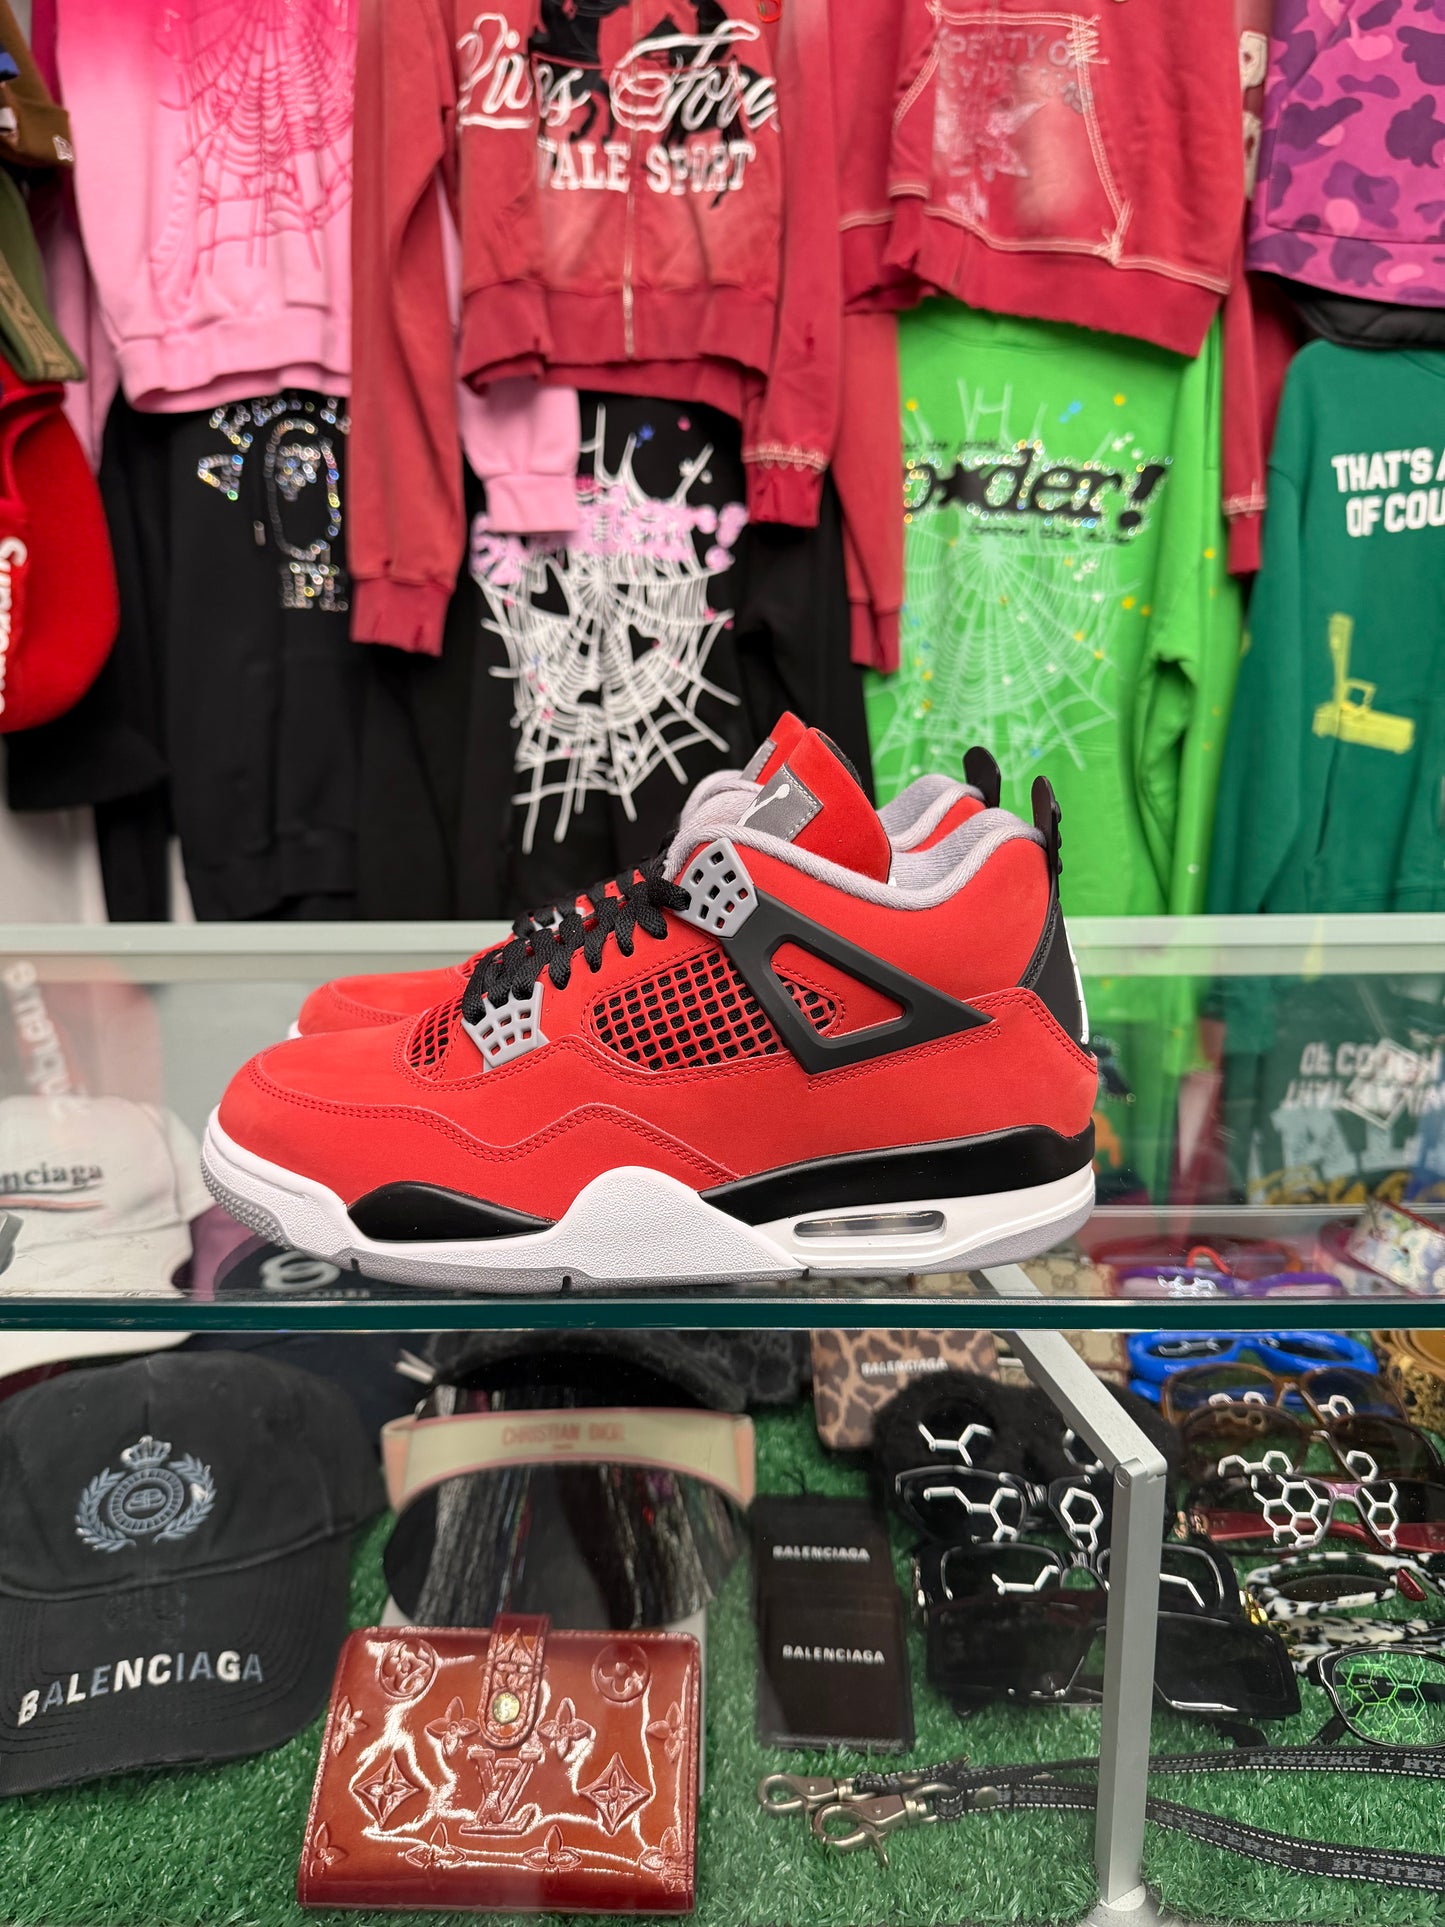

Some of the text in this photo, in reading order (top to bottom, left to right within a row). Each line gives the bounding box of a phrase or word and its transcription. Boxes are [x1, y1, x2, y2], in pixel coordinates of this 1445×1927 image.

[1331, 447, 1434, 493] THAT'S
[1345, 487, 1445, 538] OF COU
[861, 1357, 948, 1377] BALENCIAGA
[771, 1545, 870, 1561] BALENCIAGA
[782, 1644, 886, 1665] BALENCIAGA
[17, 1650, 264, 1727] BALENCIAGA
[1249, 1755, 1371, 1766] HYSTERIC
